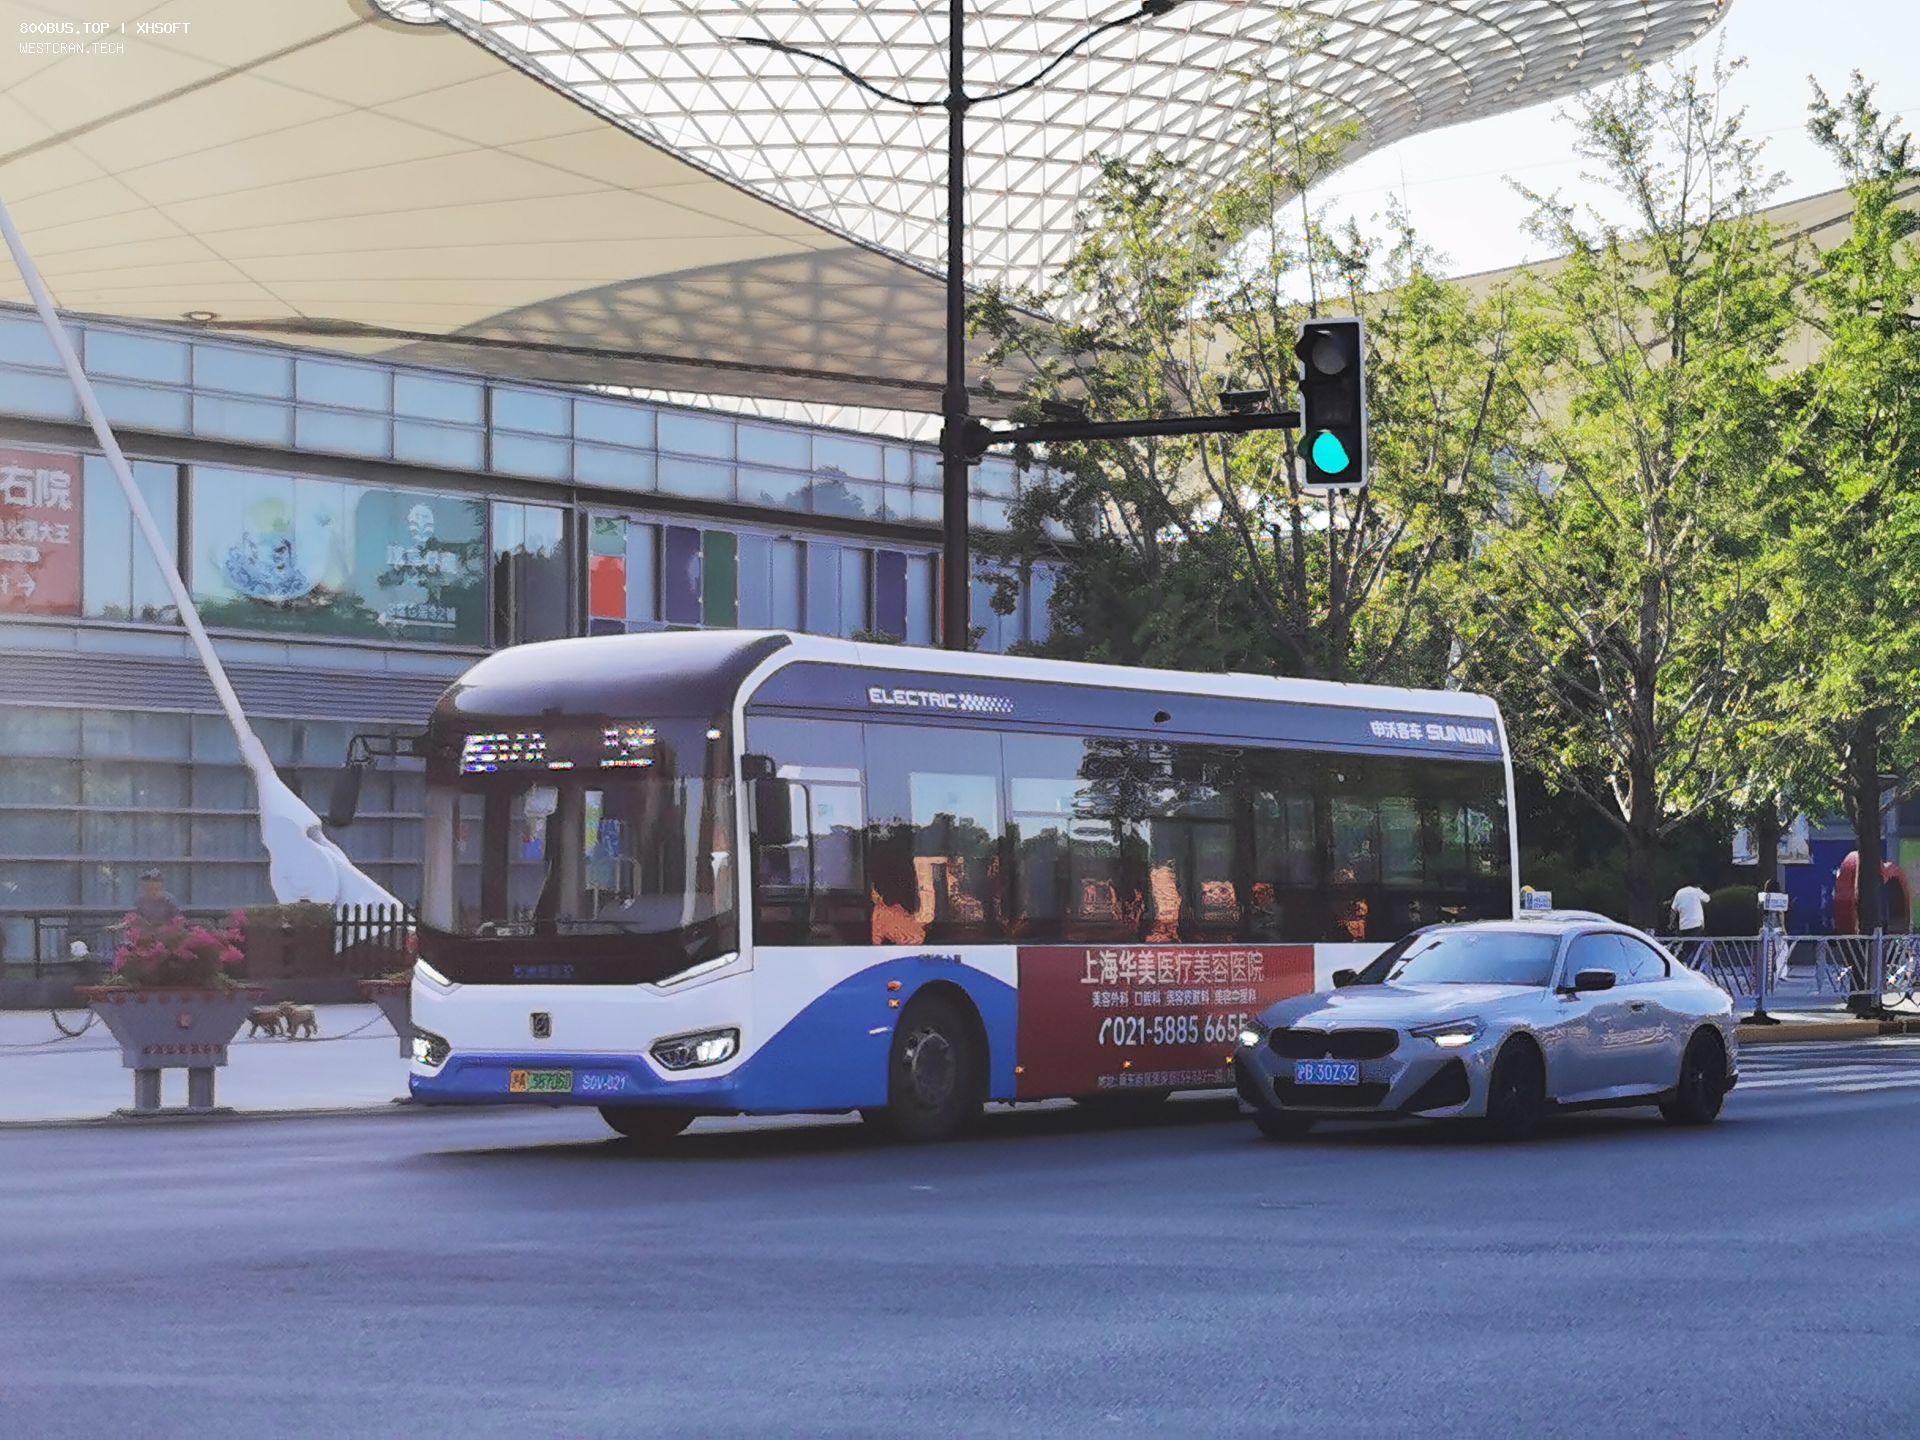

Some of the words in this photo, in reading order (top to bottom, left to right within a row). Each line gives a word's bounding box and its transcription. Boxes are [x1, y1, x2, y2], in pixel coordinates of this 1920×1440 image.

[868, 687, 957, 709] ELECTRIC
[1369, 720, 1423, 740] 申沃客车
[1425, 723, 1494, 745] SUNWIN
[1080, 949, 1265, 985] 上海华美医疗美容医院
[1092, 991, 1129, 1008] 美容外科
[1113, 1015, 1199, 1046] 021-5885
